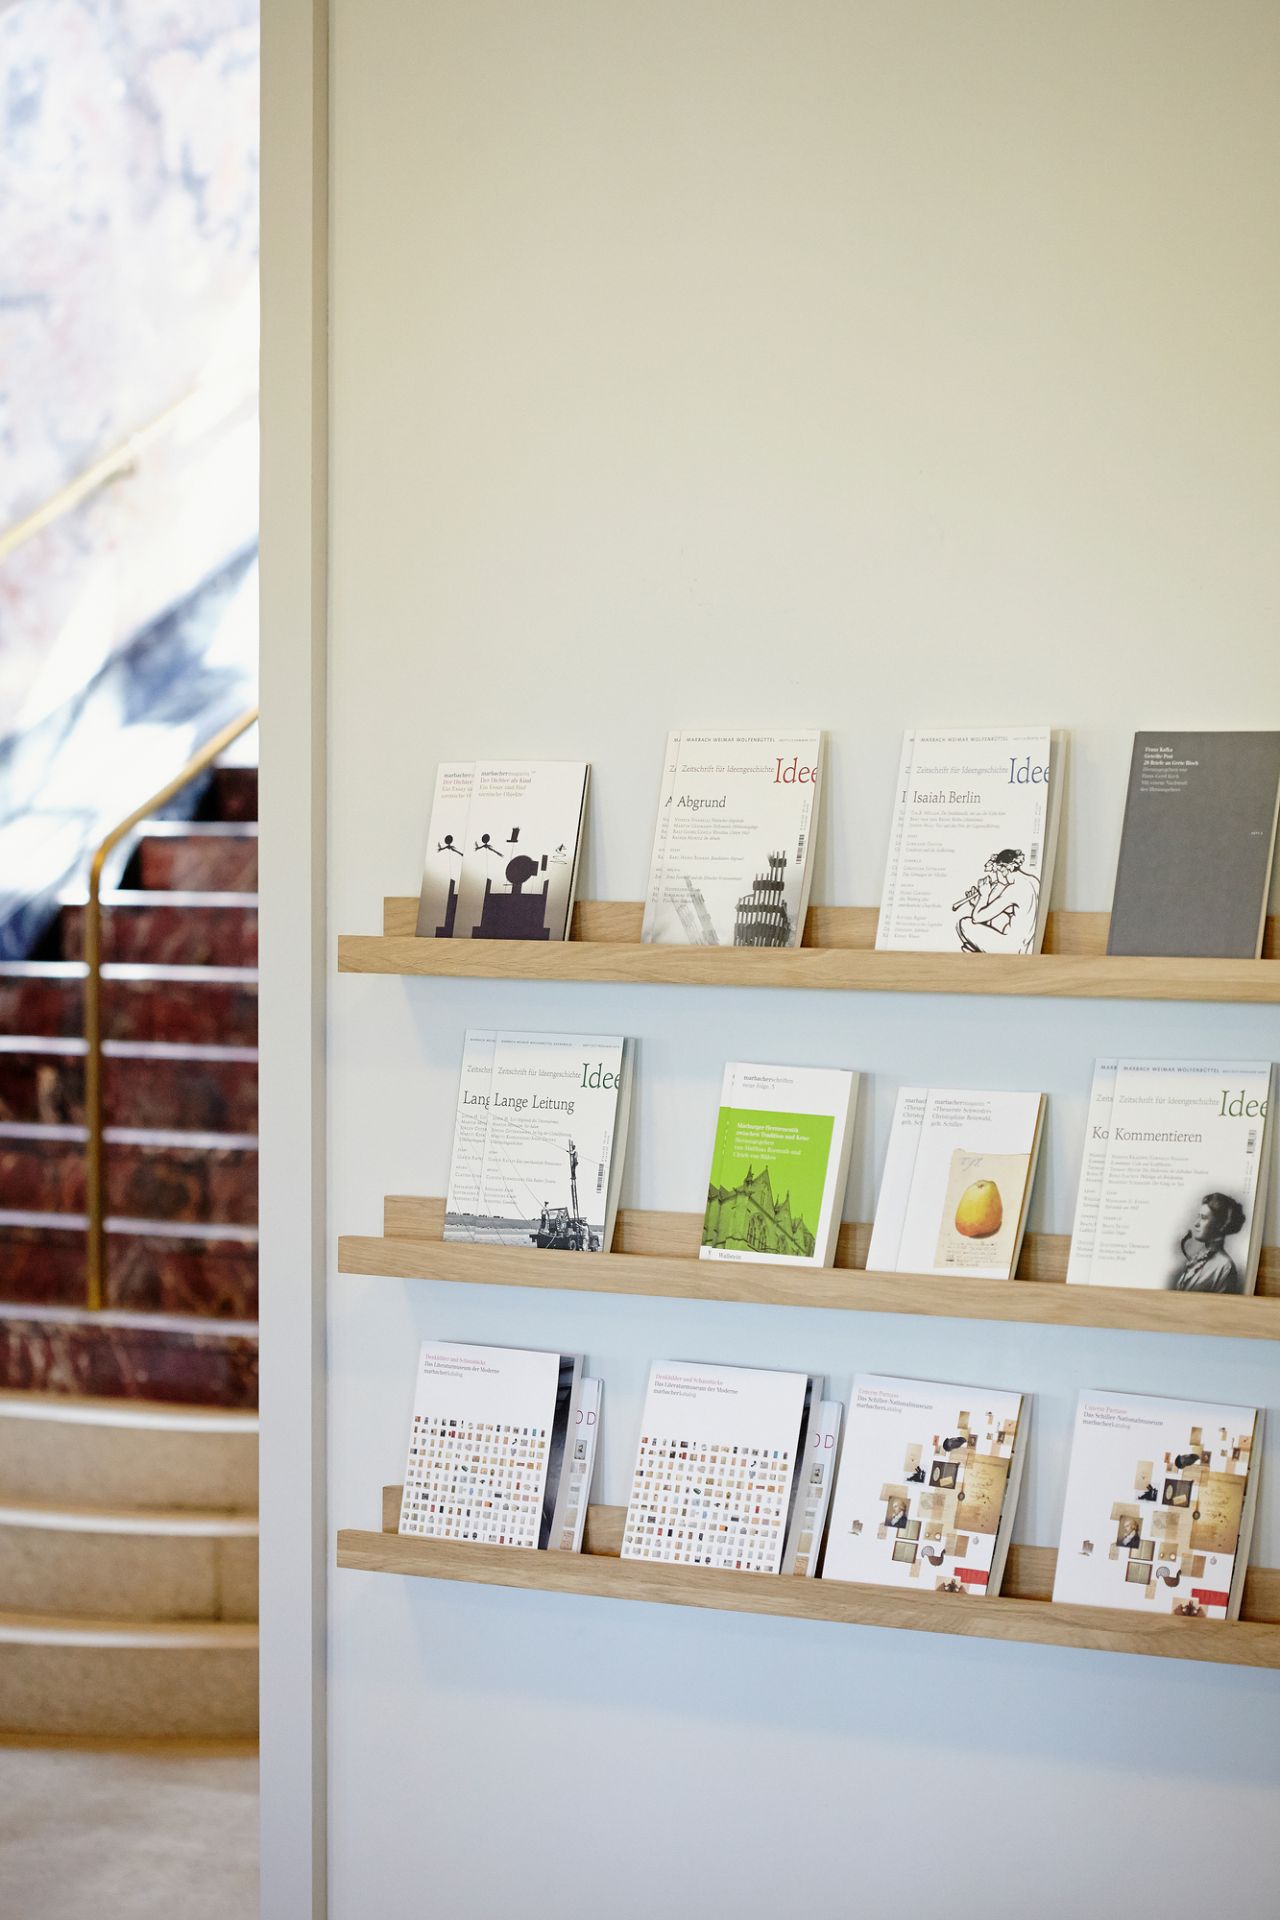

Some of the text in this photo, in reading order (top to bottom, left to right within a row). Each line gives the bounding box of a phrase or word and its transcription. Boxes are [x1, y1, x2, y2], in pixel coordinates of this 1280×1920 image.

[682, 757, 818, 784] Zeitschrift für Ideengeschichte Idee
[916, 766, 948, 774] Zeitschrift
[950, 766, 960, 774] für
[962, 766, 1008, 776] Ideengeschichte
[677, 796, 726, 812] Abgrund
[913, 790, 981, 804] Isaiah Berlin
[498, 1062, 621, 1090] Zeitschrift für Ideengeschichte Idee
[494, 1092, 575, 1115] Lange Leitung
[1119, 1090, 1268, 1118] Zeitschrift für Ideengeschichte Idee
[1115, 1128, 1202, 1143] Kommentieren
